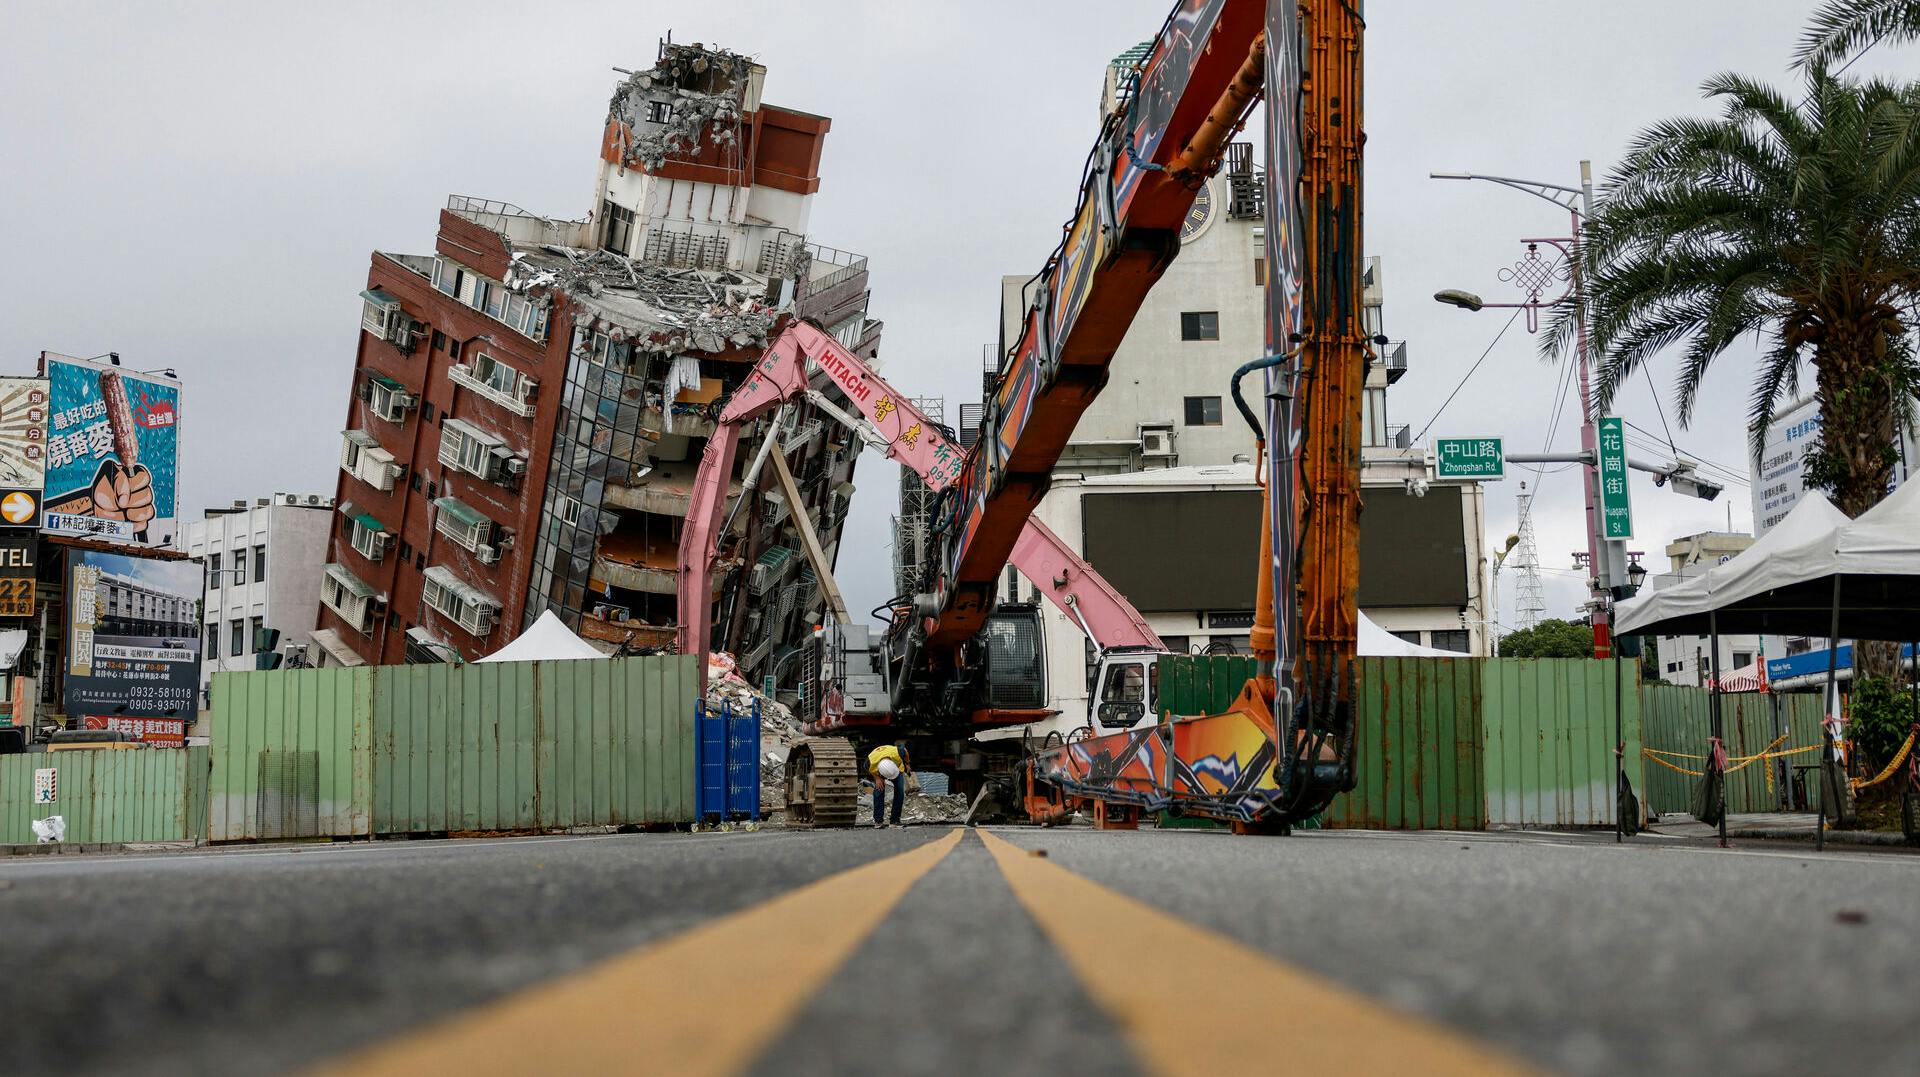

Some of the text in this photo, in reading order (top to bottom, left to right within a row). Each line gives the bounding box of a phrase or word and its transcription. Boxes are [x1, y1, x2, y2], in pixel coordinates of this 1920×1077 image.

[819, 350, 871, 402] HITACHI
[53, 400, 107, 431] 最好吃的
[147, 412, 174, 426] 全台灣
[29, 394, 42, 458] 別無分號
[1444, 441, 1496, 458] 中山路
[1444, 461, 1484, 475] Zhongshan
[1603, 434, 1623, 495] 花崗街
[1605, 505, 1628, 520] Huagang
[130, 686, 192, 699] 0932-581018
[129, 699, 191, 711] 0905-935071
[145, 719, 182, 735] 美式炸雞
